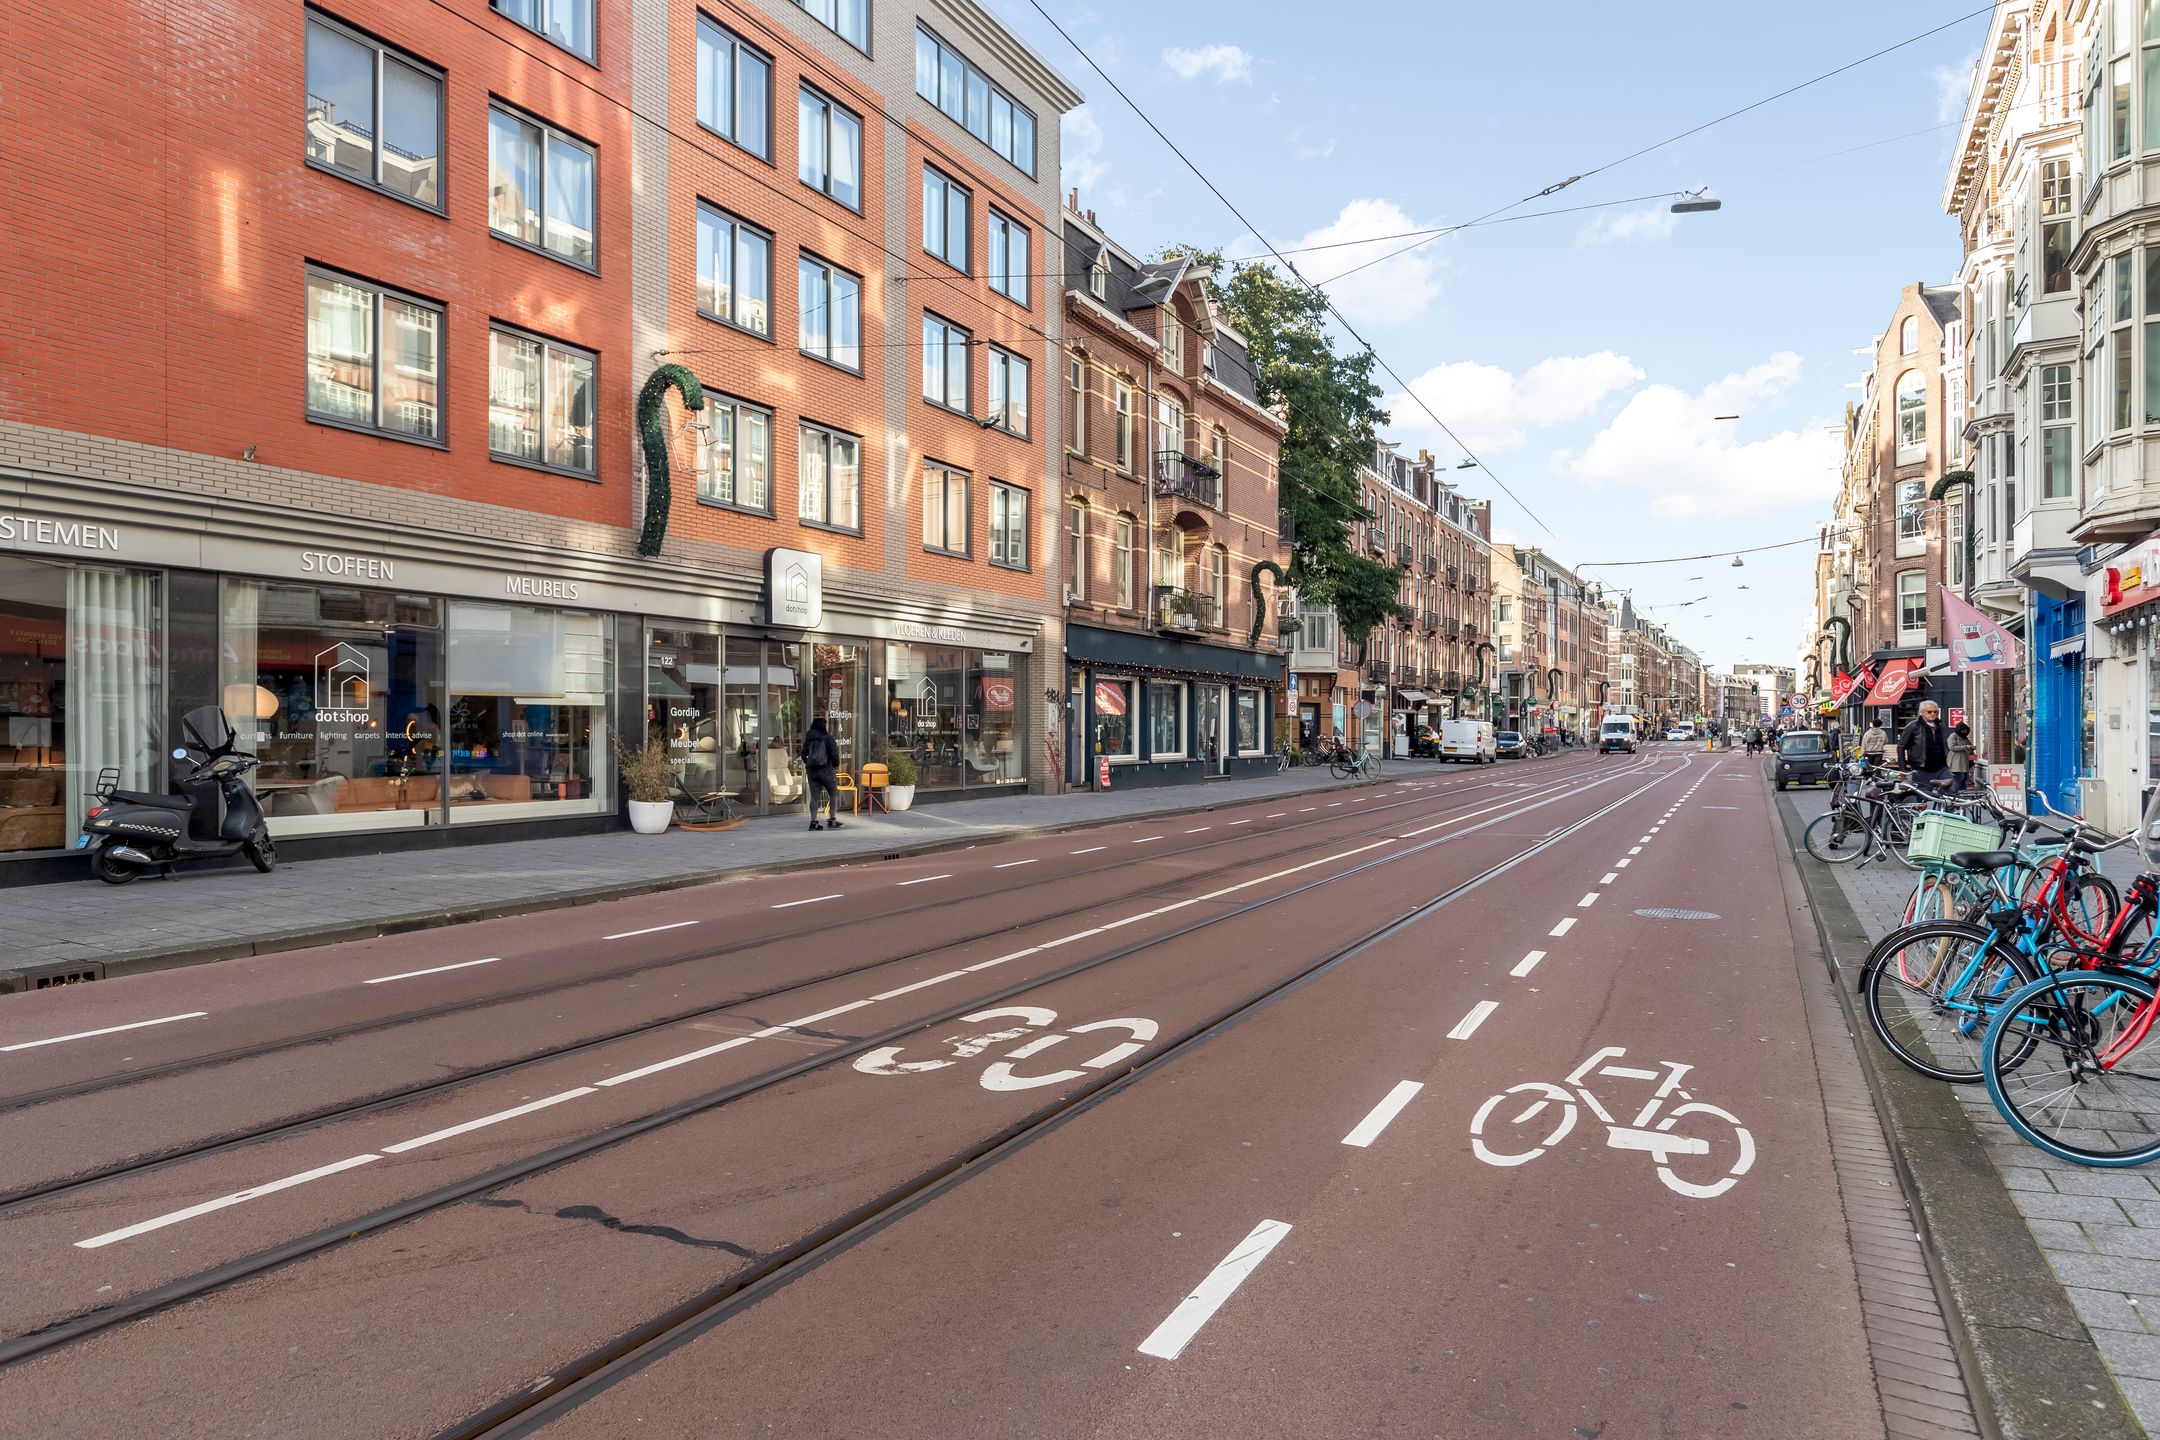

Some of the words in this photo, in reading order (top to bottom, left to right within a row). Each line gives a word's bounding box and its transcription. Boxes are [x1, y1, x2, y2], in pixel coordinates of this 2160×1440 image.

[0, 515, 119, 551] STEMEN
[301, 551, 394, 580] STOFFEN
[506, 575, 578, 600] MEUBELS
[895, 623, 930, 638] VLOEREN
[931, 626, 937, 640] &
[938, 626, 967, 642] KLEDEN
[661, 657, 673, 665] 122
[1793, 697, 1806, 705] 30
[670, 707, 700, 719] Gordijn
[829, 710, 852, 720] Gordijn
[838, 723, 843, 731] &
[240, 731, 272, 739] curtns
[279, 731, 313, 739] furniture
[320, 731, 348, 740] lighting
[354, 731, 380, 740] carpets
[411, 731, 432, 739] advise
[670, 738, 700, 748] Meubel
[835, 737, 852, 746] eubel
